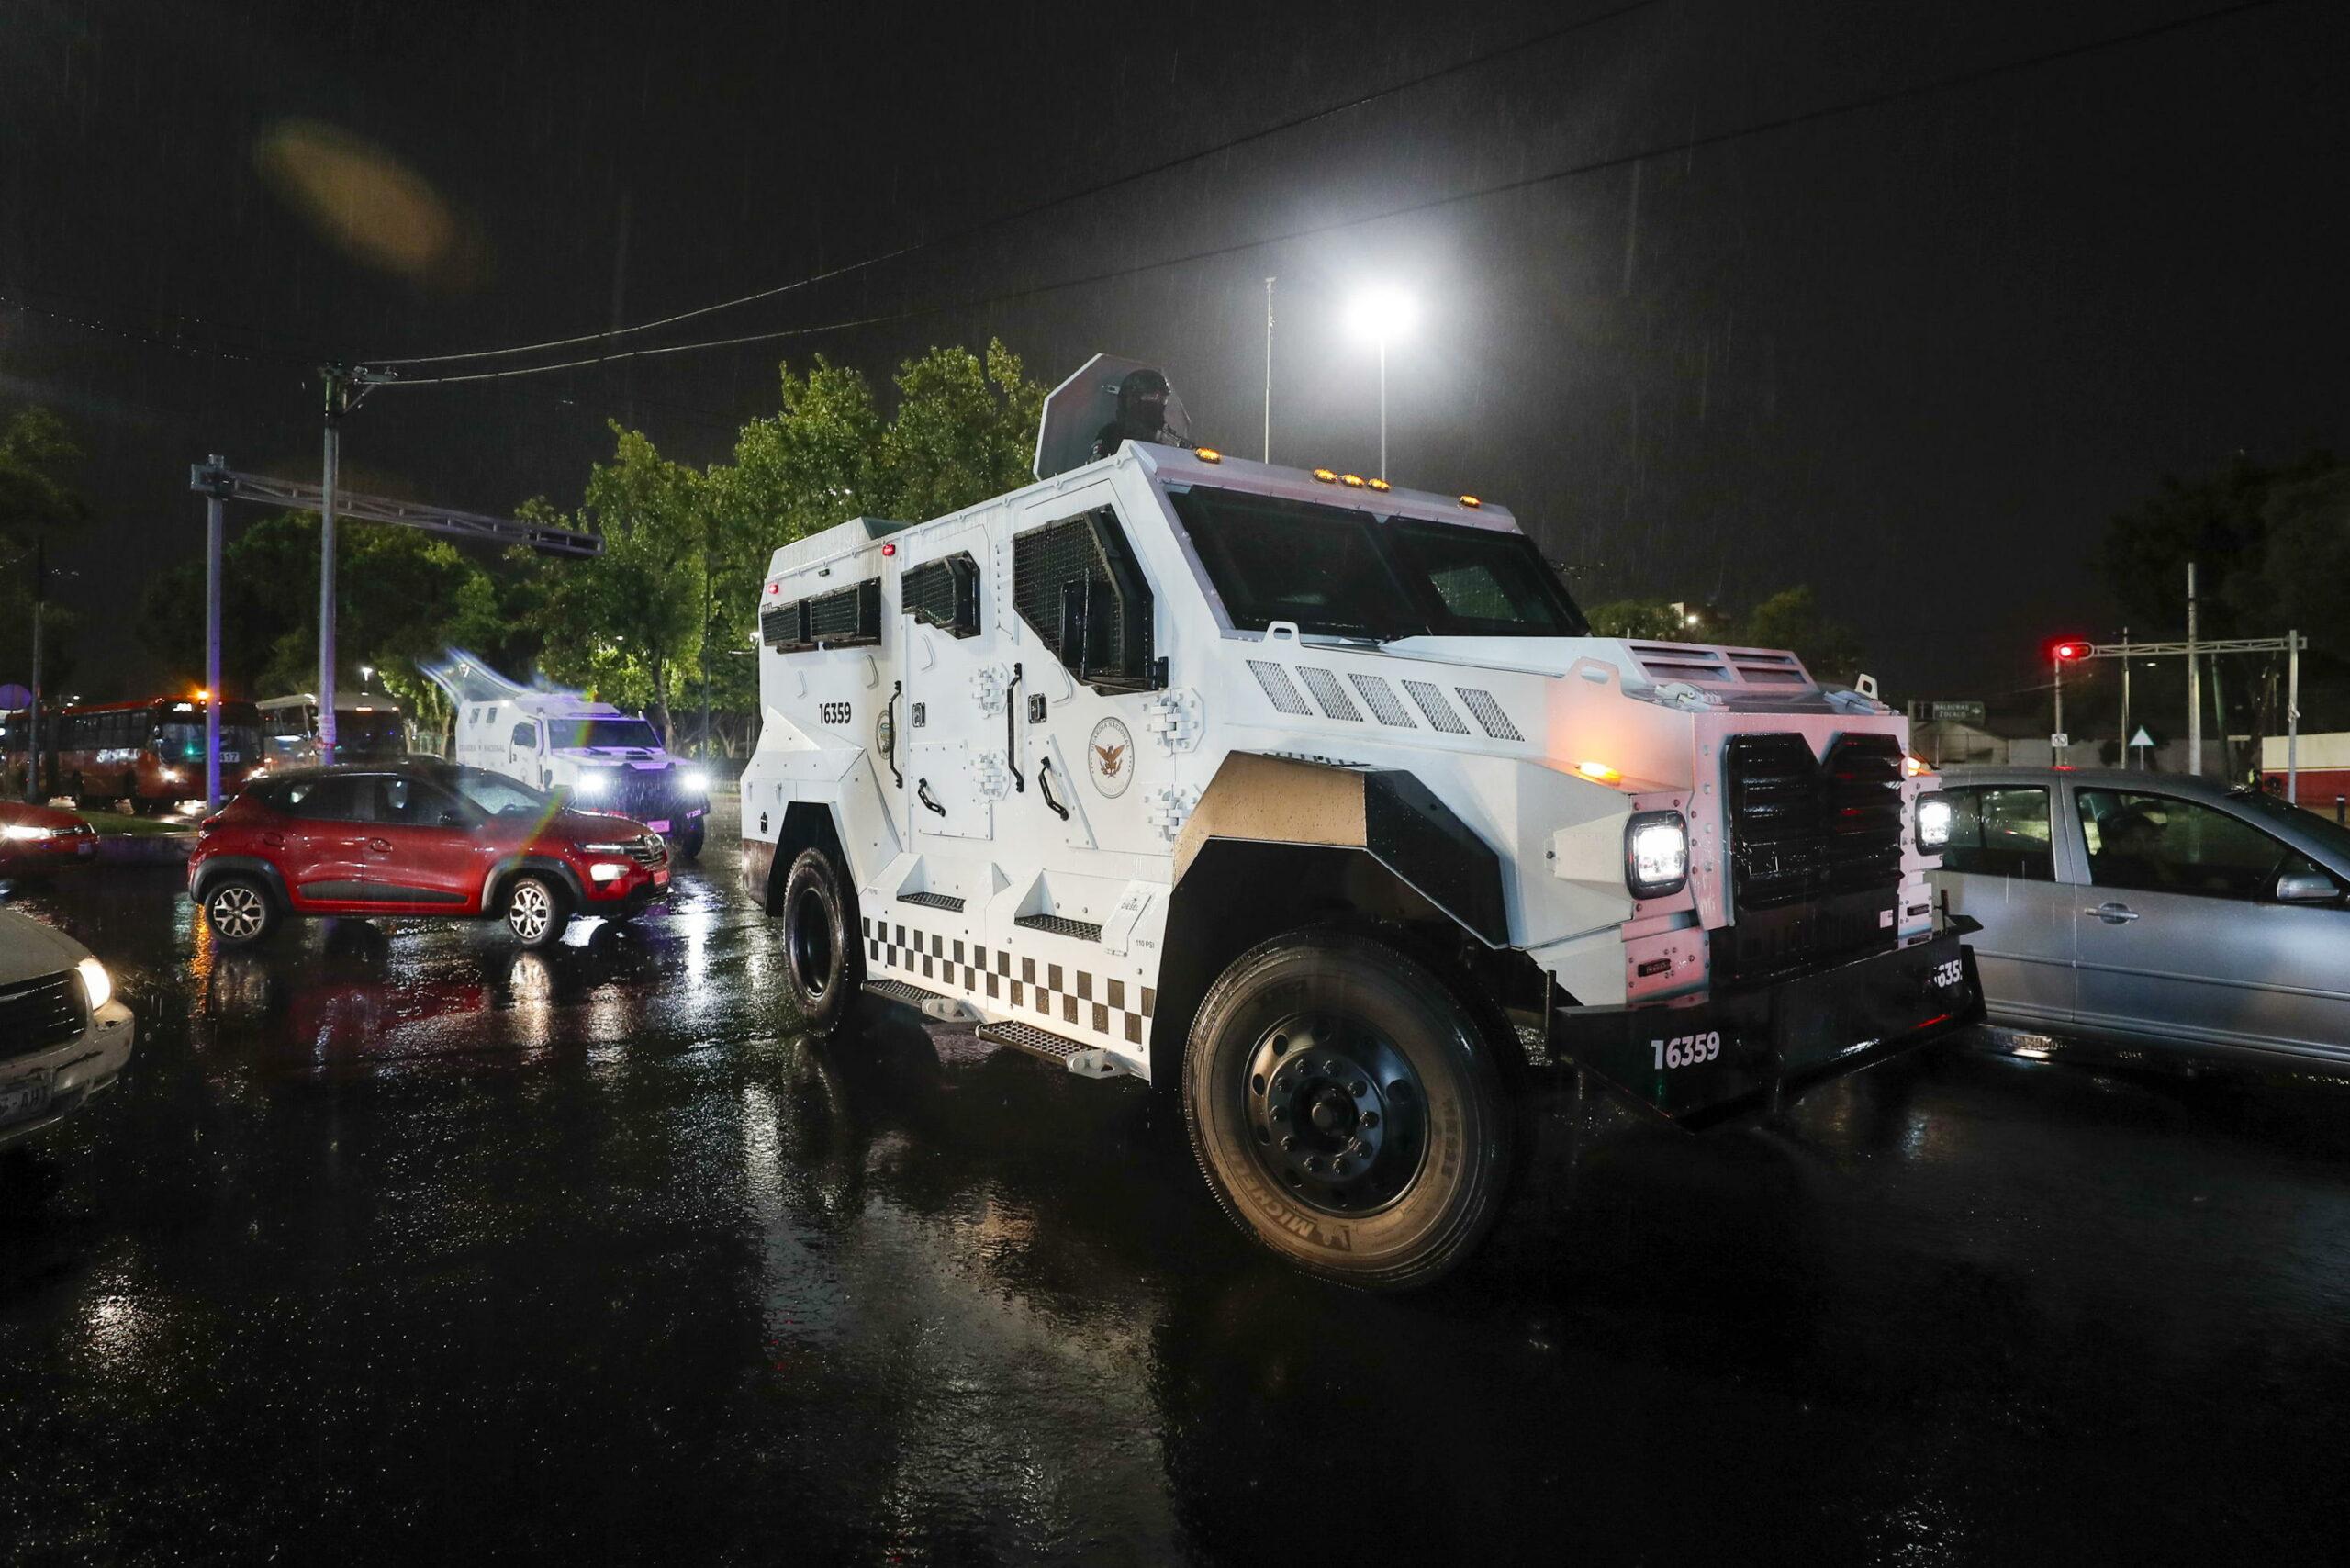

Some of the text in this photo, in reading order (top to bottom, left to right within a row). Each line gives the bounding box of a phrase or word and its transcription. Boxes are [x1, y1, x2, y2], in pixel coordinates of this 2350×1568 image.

[819, 702, 851, 724] 16359
[1091, 721, 1130, 751] GUARDIA NACIONAL
[1136, 939, 1145, 947] 110
[1651, 1031, 1720, 1070] 16359
